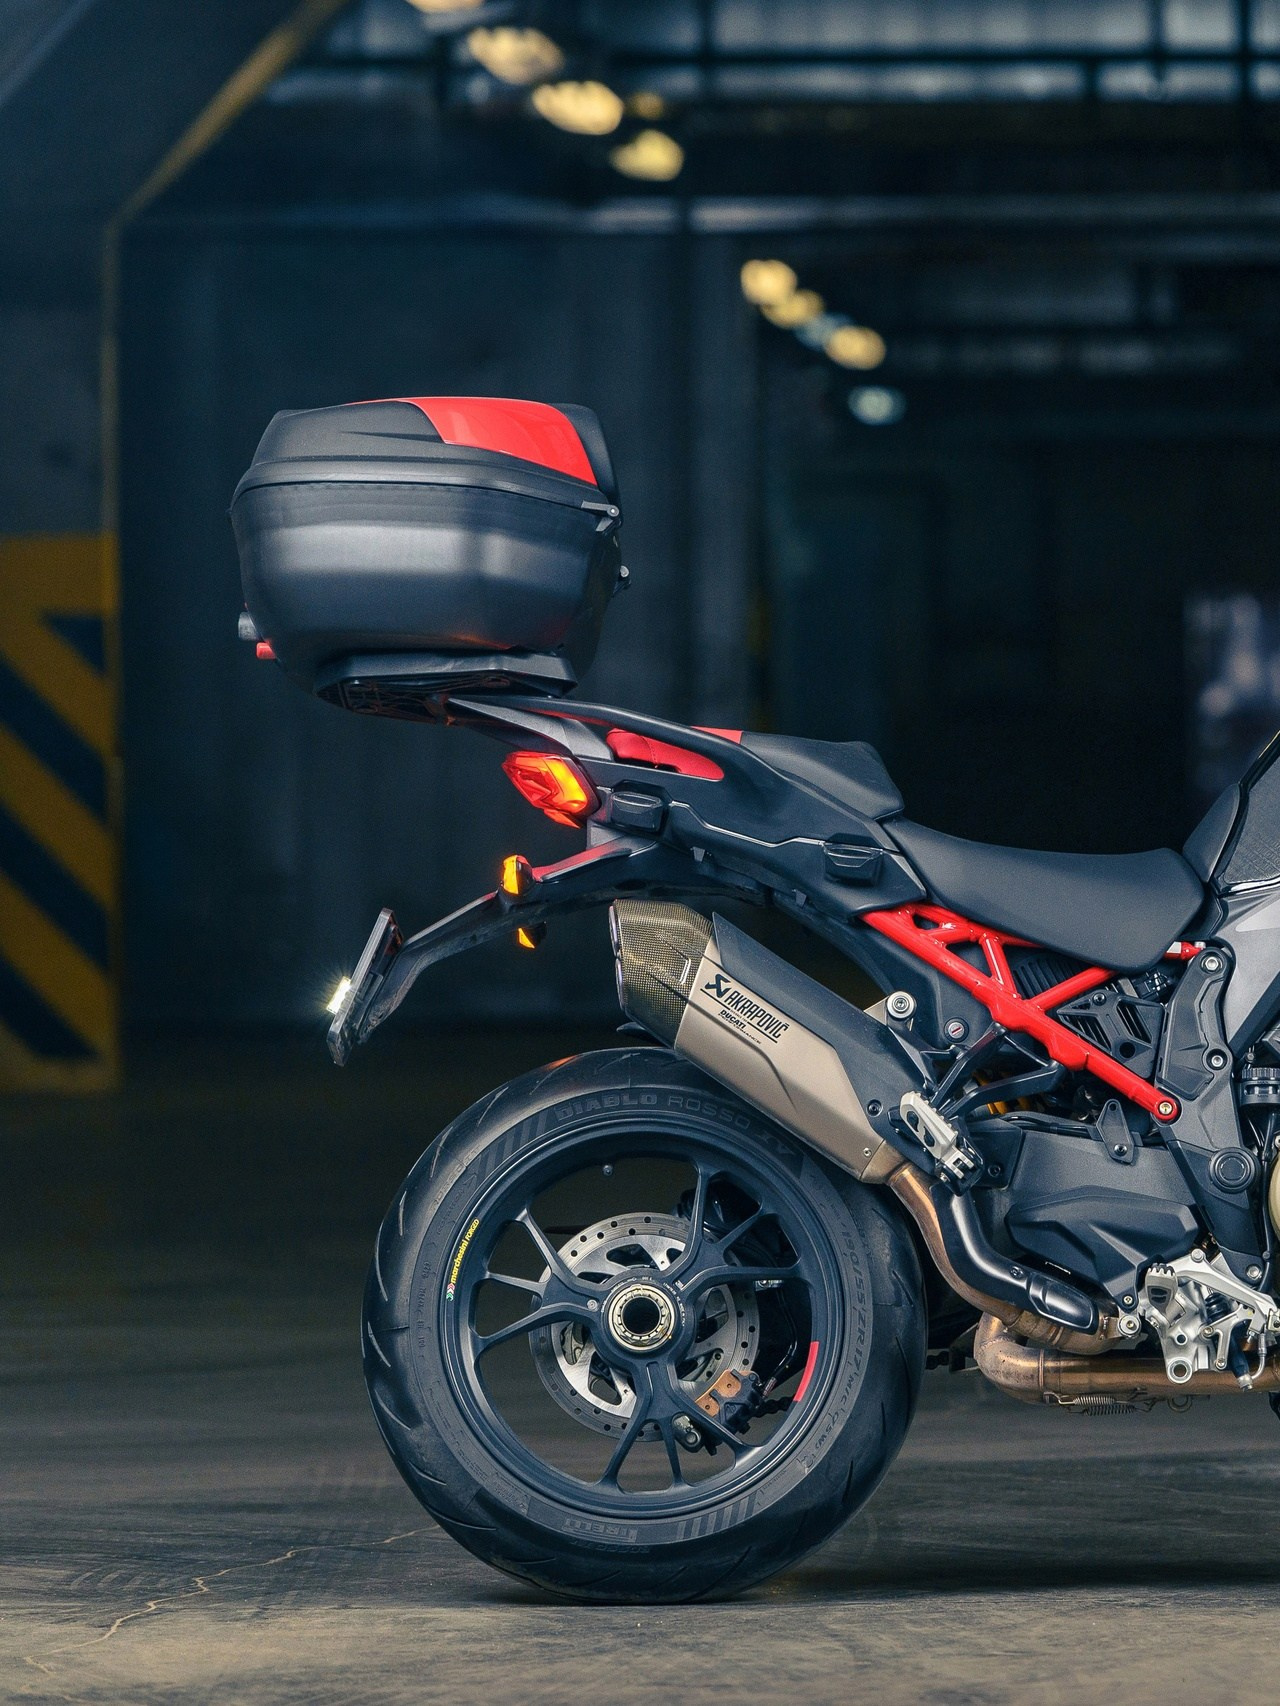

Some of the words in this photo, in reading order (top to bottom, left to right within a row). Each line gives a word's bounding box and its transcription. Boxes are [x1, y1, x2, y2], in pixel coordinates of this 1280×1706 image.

[720, 1009, 747, 1029] DUCATI
[554, 1093, 658, 1121] DIABLO
[667, 1095, 751, 1130] ROSSO
[451, 1239, 469, 1284] marchesini
[464, 1218, 480, 1241] FORGED
